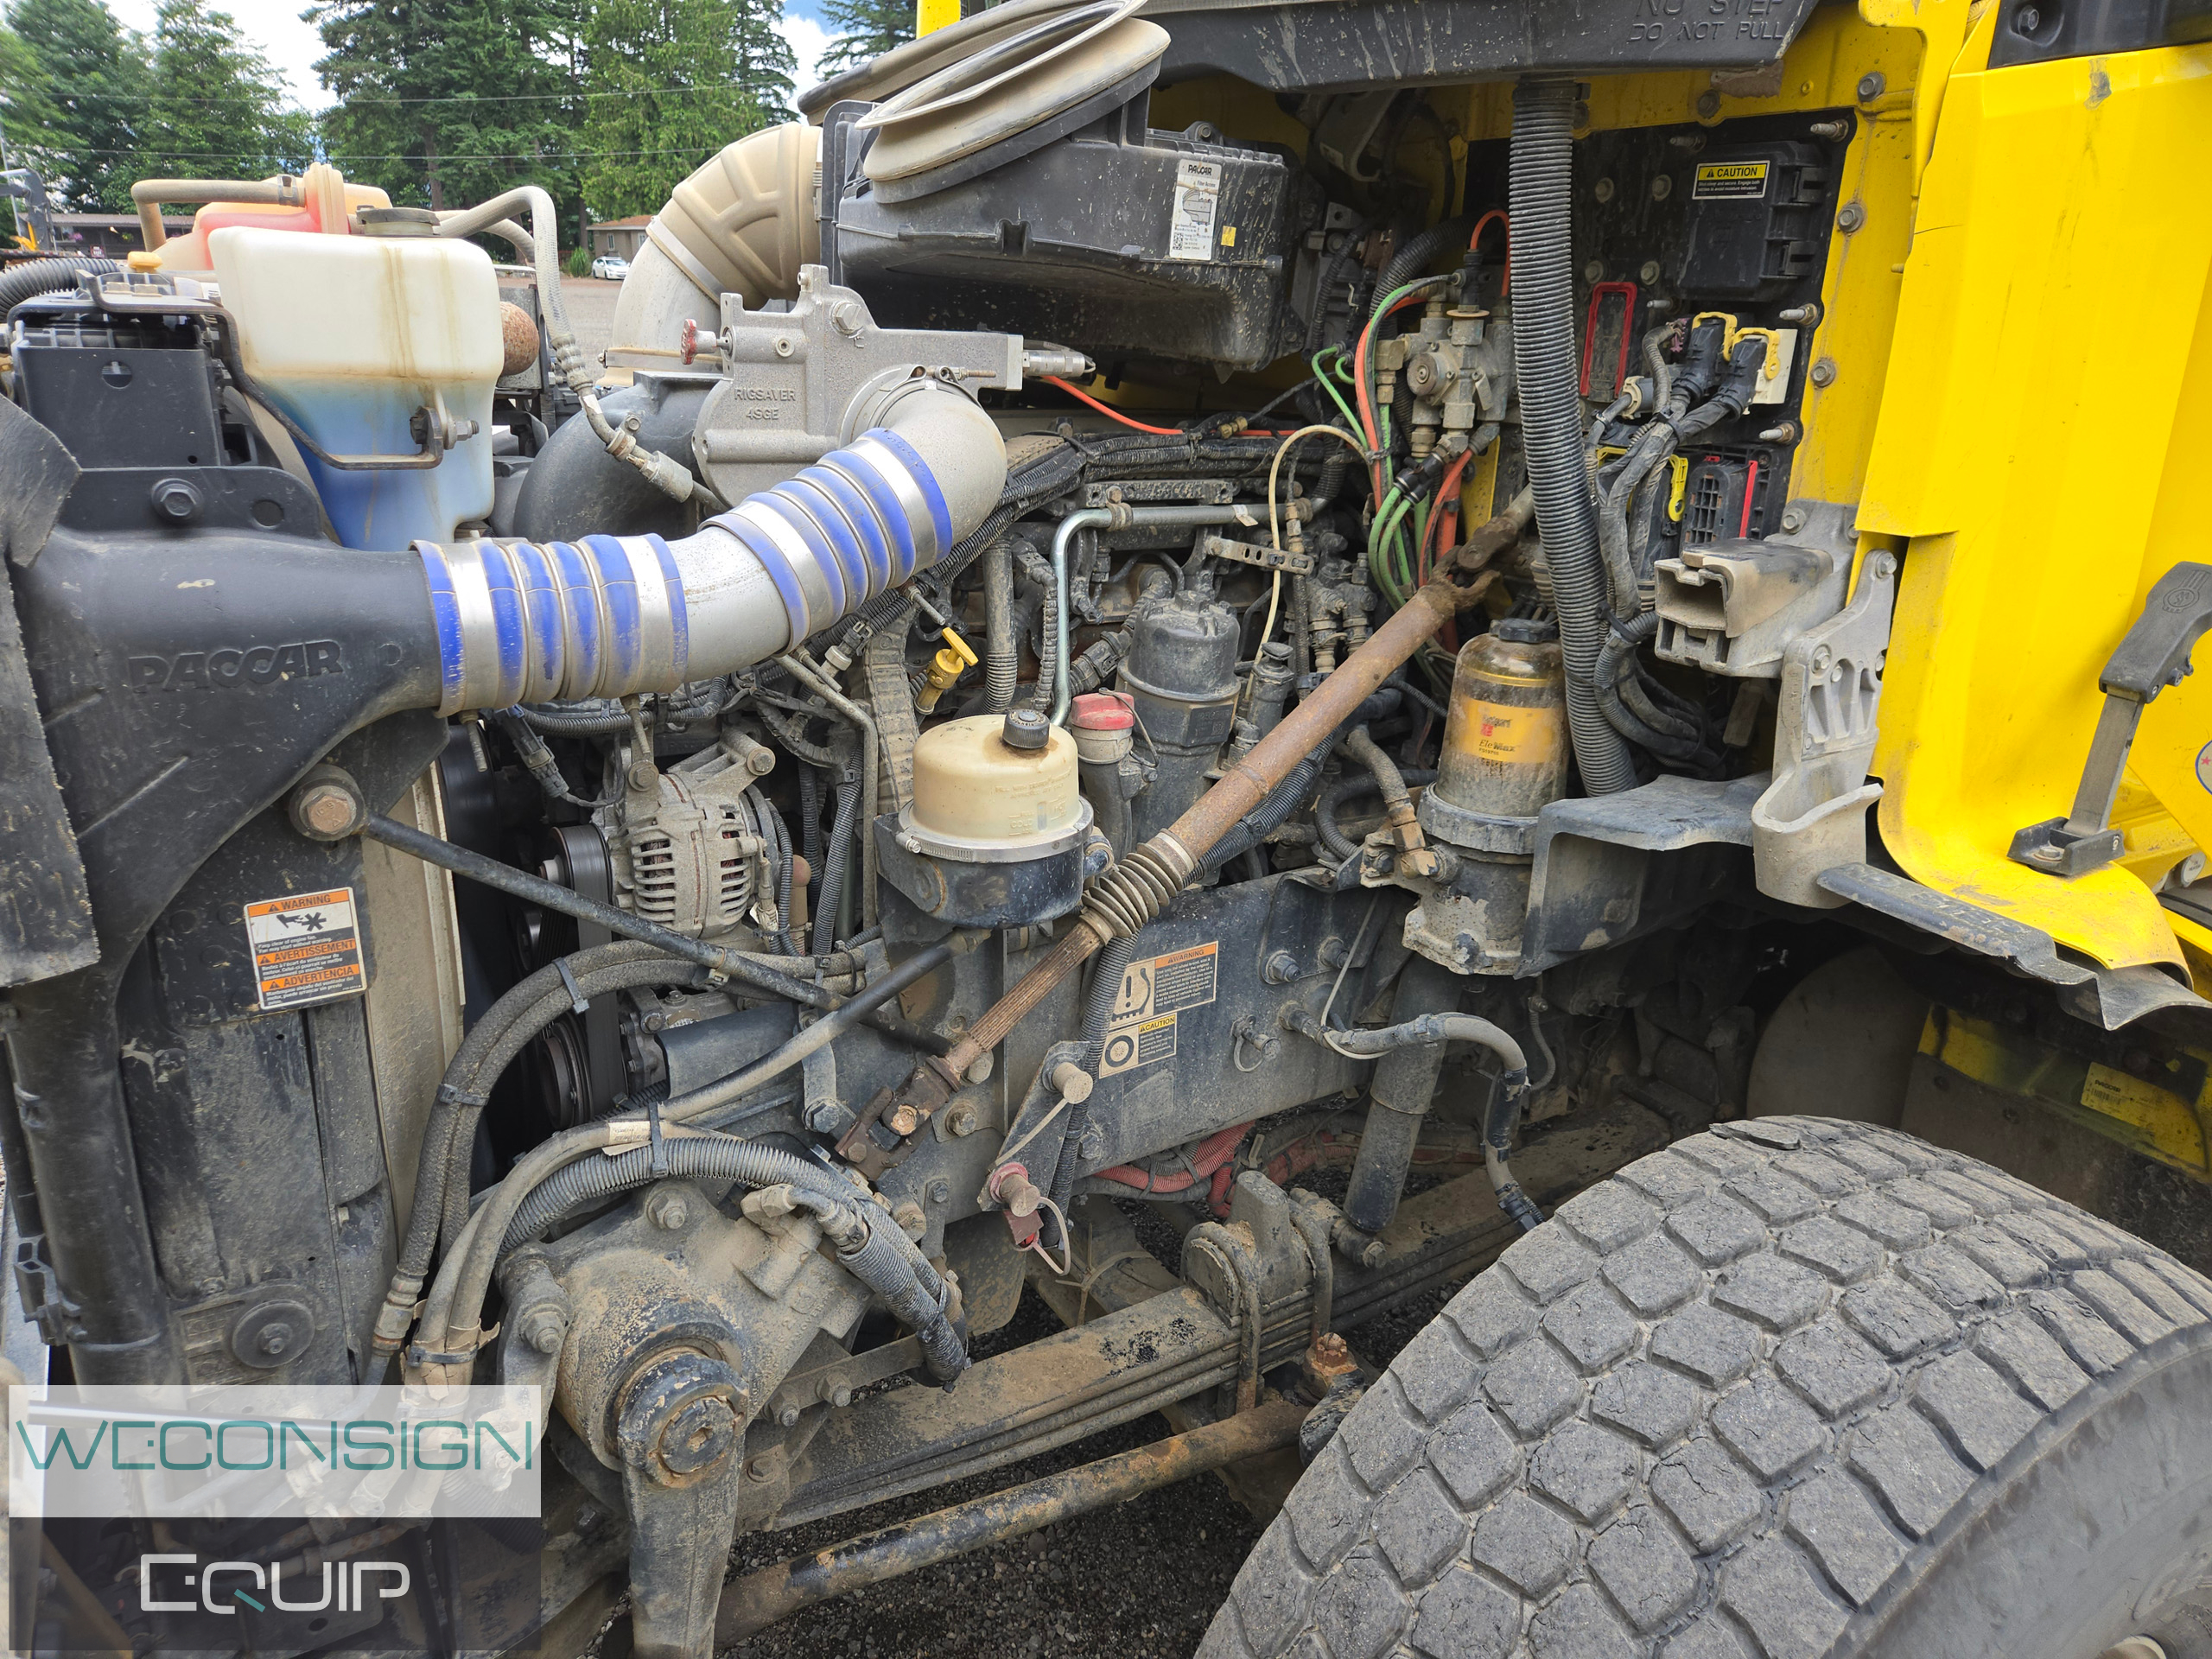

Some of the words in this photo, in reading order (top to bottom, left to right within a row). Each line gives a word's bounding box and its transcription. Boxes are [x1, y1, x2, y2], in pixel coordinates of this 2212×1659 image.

[1628, 22, 1665, 41] DO
[1677, 21, 1725, 41] NOT
[1736, 21, 1784, 40] PULL
[1188, 164, 1212, 175] PACCAR
[1717, 167, 1758, 177] CAUTION
[734, 388, 796, 402] RIGSAVER
[128, 639, 345, 695] PACCAR
[282, 894, 331, 910] WARNING
[273, 940, 353, 962] AVERTISSEMENT
[1173, 949, 1204, 962] WARNING
[283, 966, 353, 987] ADVERTENCIA
[1146, 1017, 1174, 1031] CAUTION
